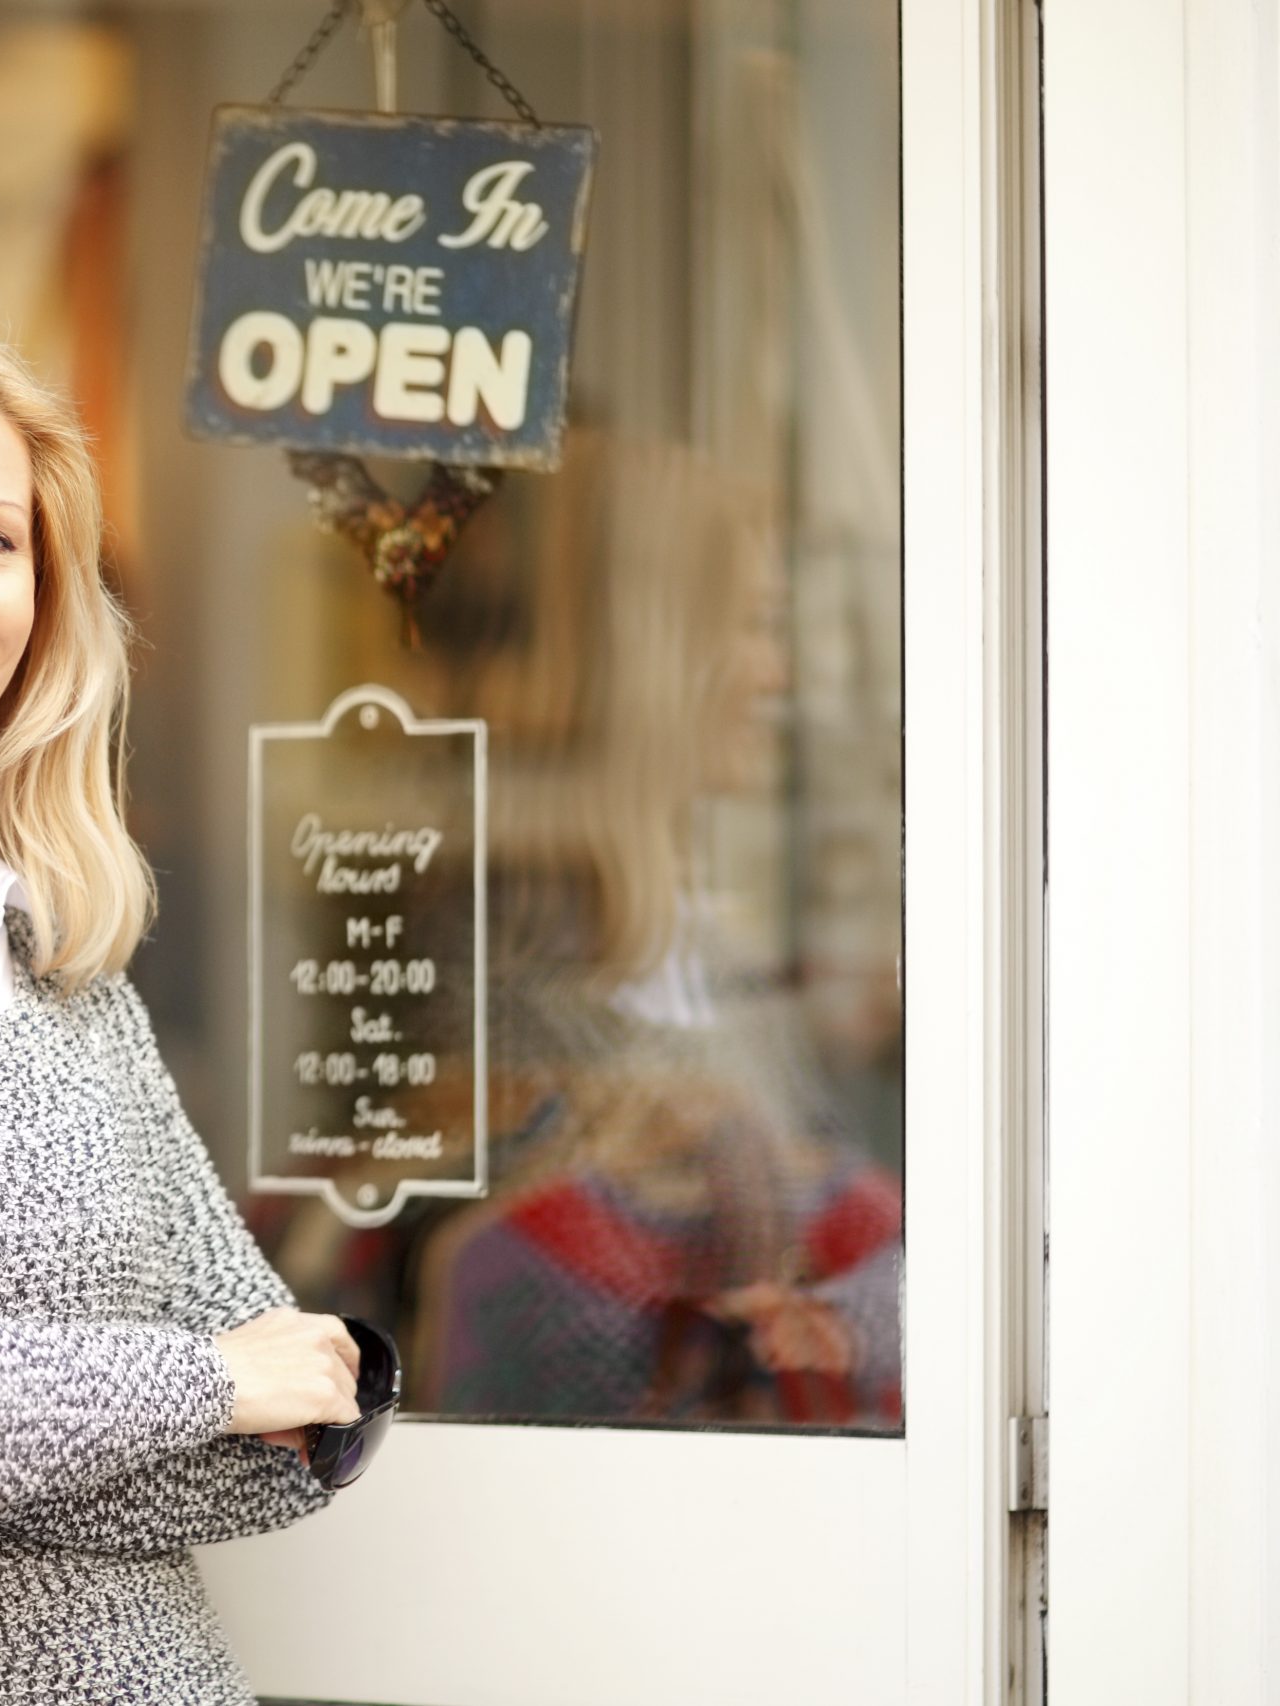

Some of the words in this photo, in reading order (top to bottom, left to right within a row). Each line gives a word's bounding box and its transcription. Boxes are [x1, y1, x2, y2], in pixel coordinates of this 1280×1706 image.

[240, 142, 426, 253] Come
[438, 160, 549, 252] In
[304, 258, 445, 316] WE'RE
[219, 311, 532, 431] OPEN
[291, 812, 443, 876] Opening
[317, 854, 401, 894] hours
